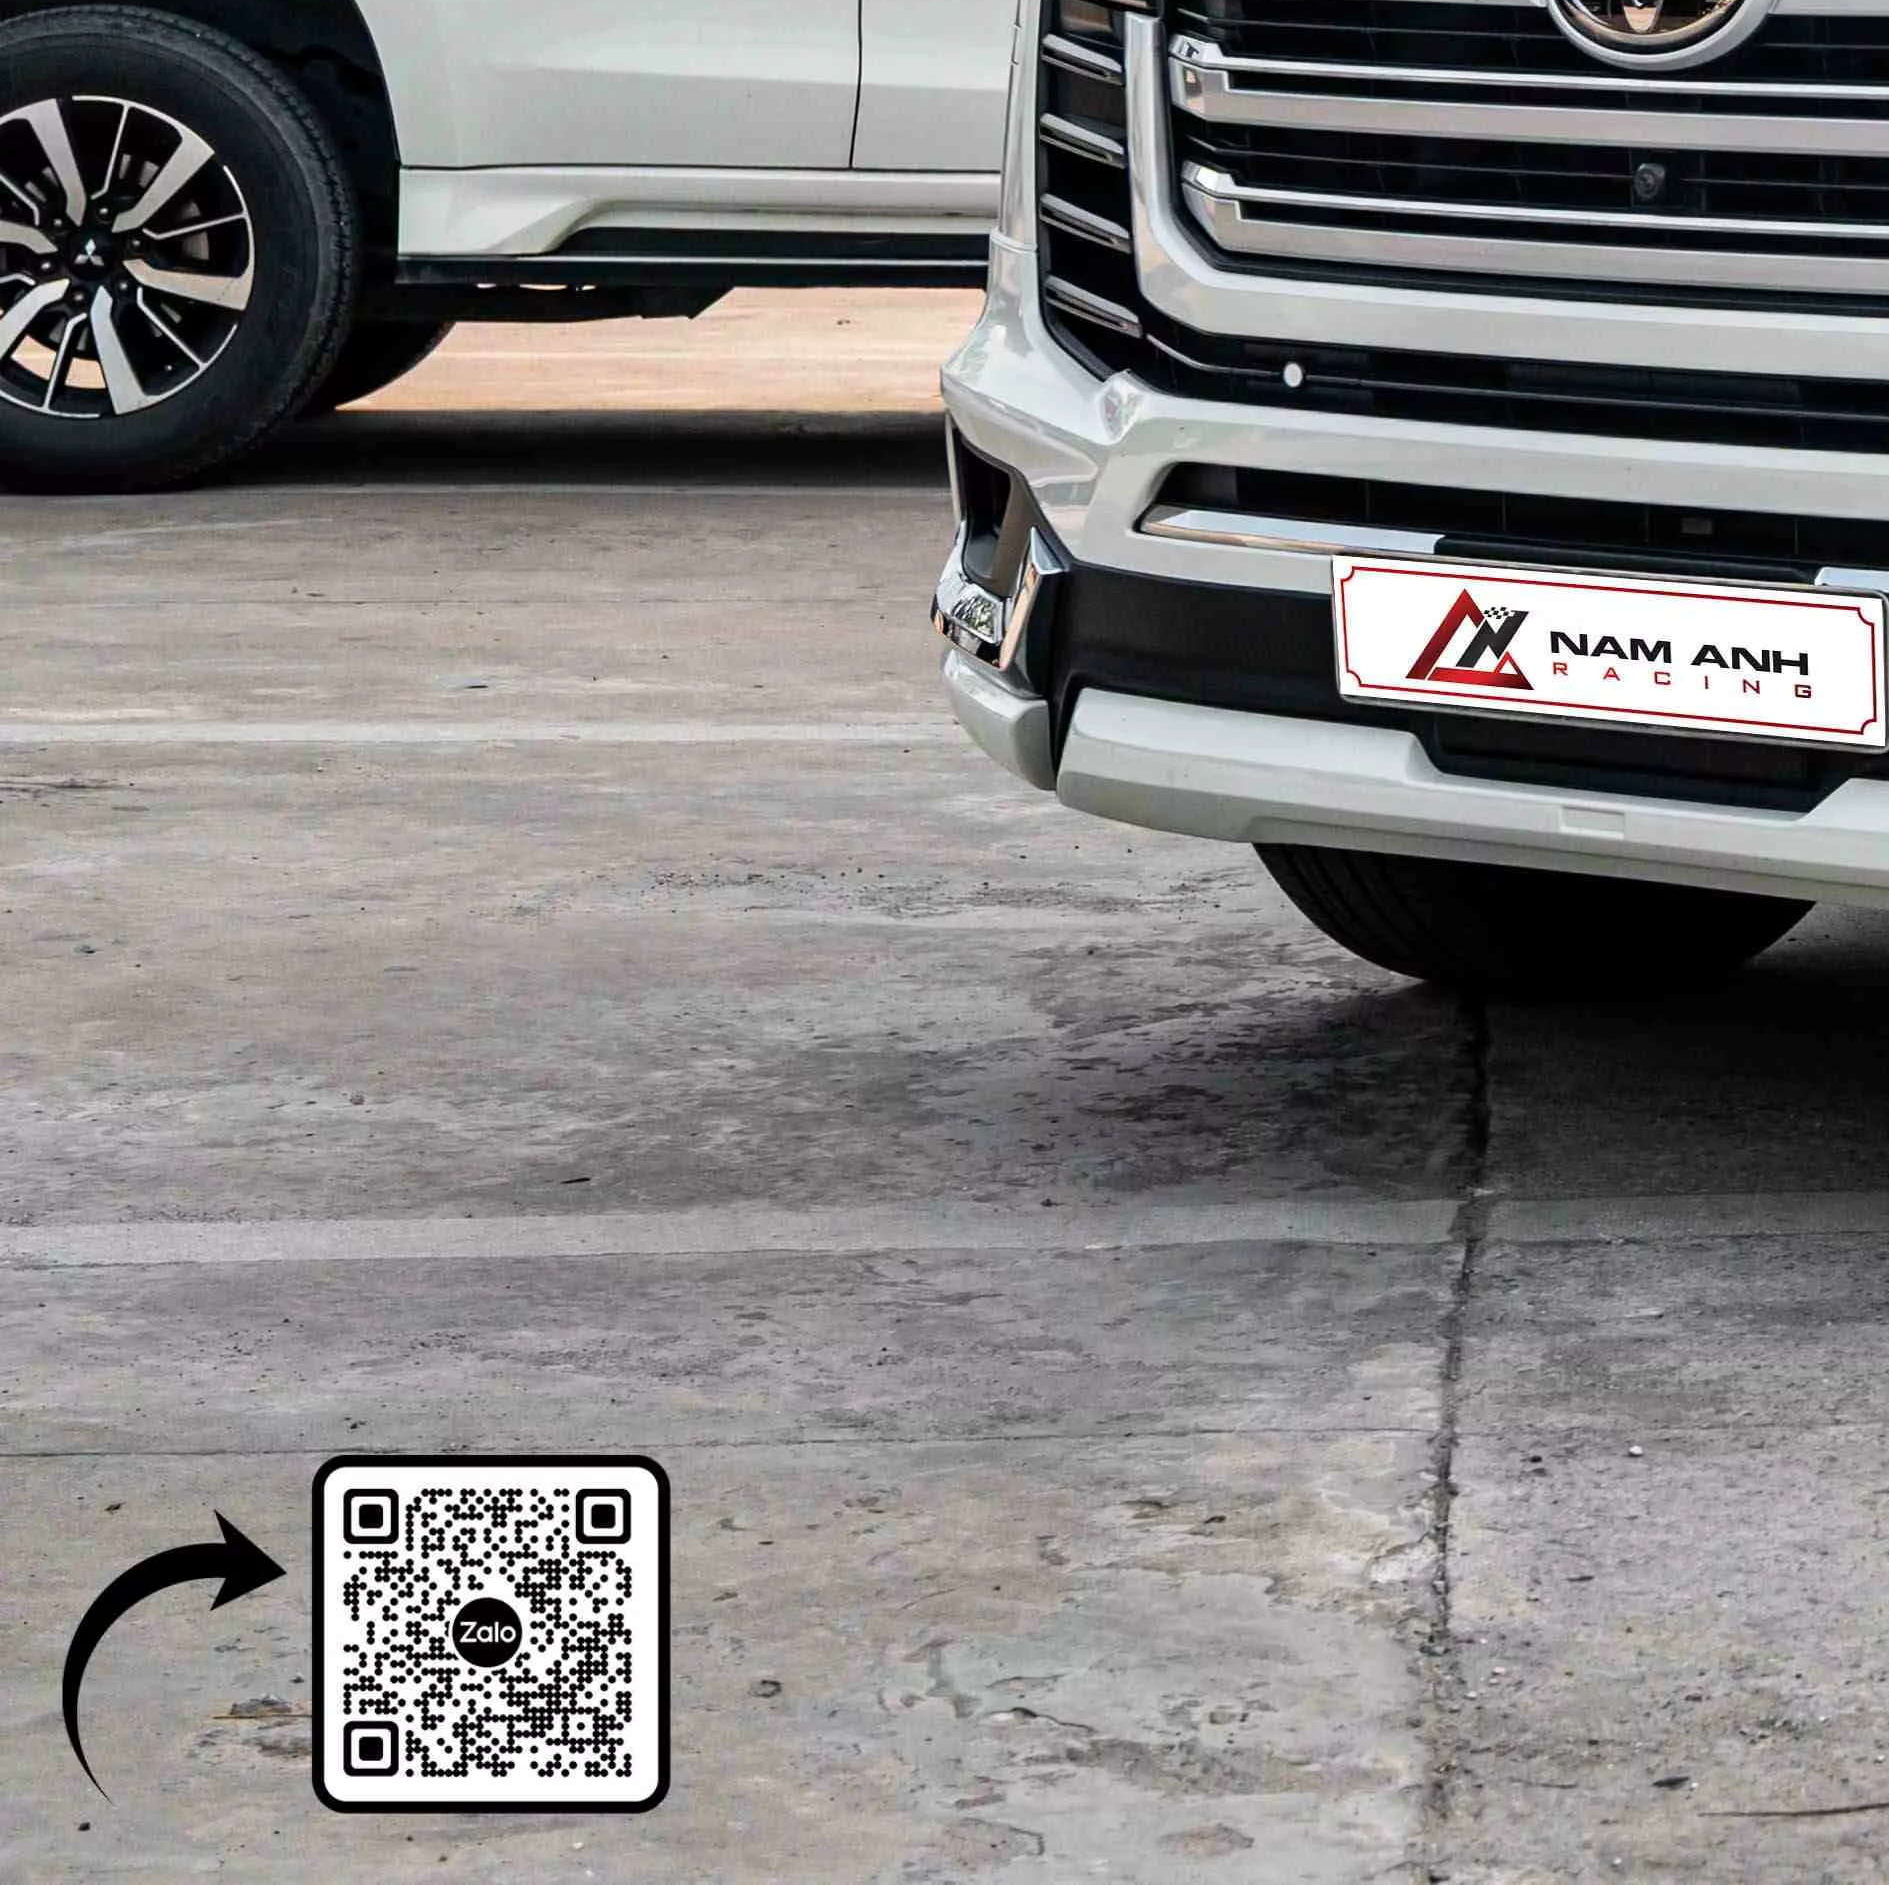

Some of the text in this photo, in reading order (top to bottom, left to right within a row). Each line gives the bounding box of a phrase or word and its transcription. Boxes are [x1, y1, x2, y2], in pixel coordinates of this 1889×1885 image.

[1550, 631, 1809, 676] NAM ANH
[1553, 662, 1812, 699] RACING
